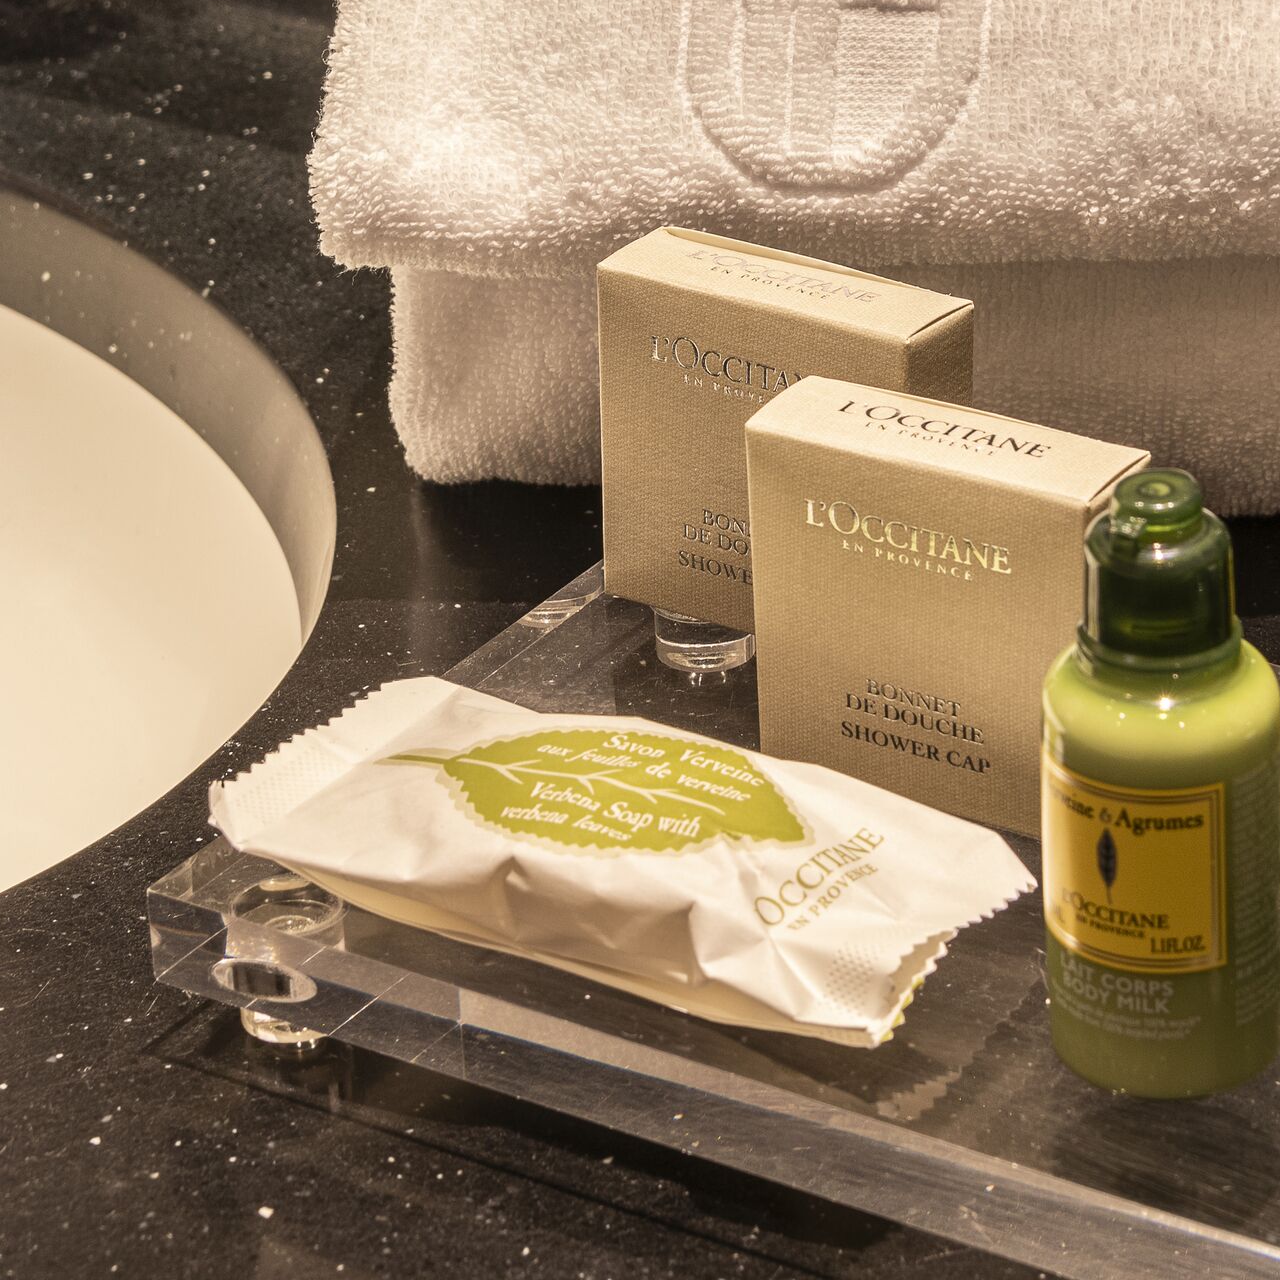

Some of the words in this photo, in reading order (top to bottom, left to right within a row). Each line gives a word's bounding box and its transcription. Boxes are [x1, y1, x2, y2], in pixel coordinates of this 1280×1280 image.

[685, 247, 881, 303] L'OCCITANE
[710, 266, 730, 276] EN
[738, 274, 832, 300] PROVENCE
[650, 335, 803, 393] L'OCCITA
[683, 374, 703, 388] EN
[713, 382, 766, 404] PROVE
[837, 400, 1052, 459] L'OCCITANE
[865, 421, 887, 431] EN
[898, 429, 999, 456] PROVENCE
[683, 524, 712, 546] DE
[702, 508, 751, 537] BON
[804, 498, 1013, 575] L'OCCITANE
[678, 550, 754, 586] SHOWE
[841, 540, 864, 554] EN
[874, 547, 974, 581] PROVENCE
[846, 692, 876, 717] DE
[884, 698, 985, 745] DOUCHE
[866, 678, 961, 718] BONNET
[602, 732, 666, 759] Savon
[680, 748, 766, 788] Verveine
[841, 720, 940, 762] SHOWER
[946, 750, 992, 774] CAP
[536, 741, 569, 759] aux
[575, 748, 642, 770] feuilles
[645, 761, 672, 780] de
[676, 774, 753, 803] verveine
[500, 803, 567, 826] verbena
[572, 814, 633, 842] leaves
[530, 781, 601, 813] Verbena
[602, 800, 654, 833] Soap
[657, 813, 701, 839] with
[1114, 808, 1205, 836] Agrumes
[753, 827, 885, 926] OCCITANE
[808, 863, 879, 918] PROVENCE
[1101, 973, 1175, 998] CORPS
[1116, 994, 1171, 1015] MILK
